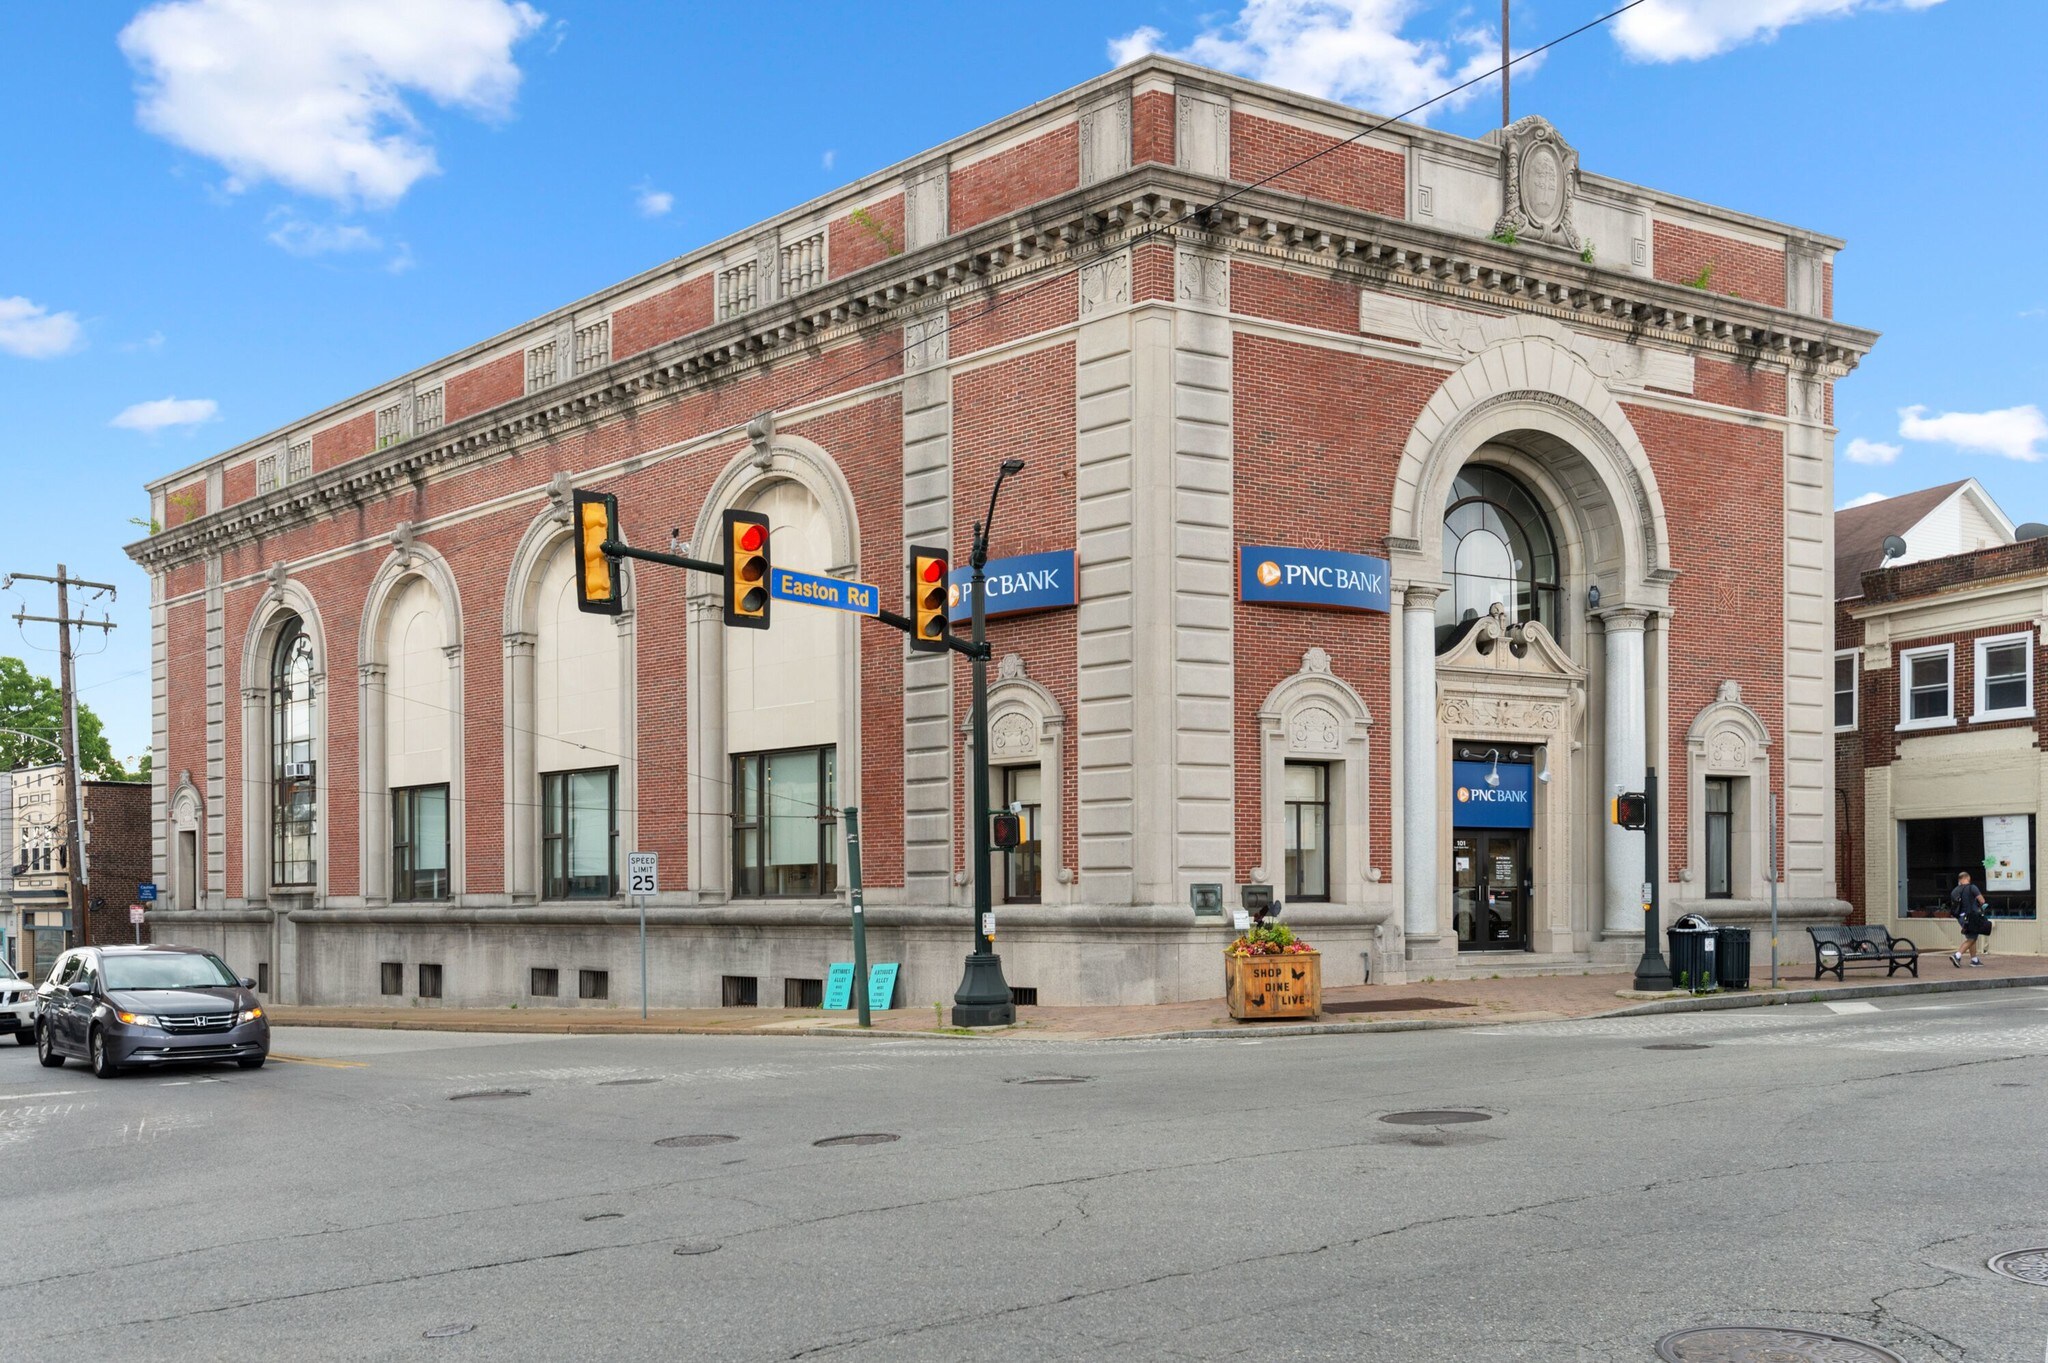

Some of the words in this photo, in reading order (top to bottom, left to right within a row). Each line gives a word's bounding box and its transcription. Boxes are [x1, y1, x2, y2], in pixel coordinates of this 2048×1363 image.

[782, 575, 838, 602] Easton
[848, 586, 869, 607] Rd
[633, 875, 654, 891] 25
[1253, 969, 1282, 978] SHOP
[1265, 983, 1289, 992] DINE
[1282, 996, 1304, 1005] LIVE
